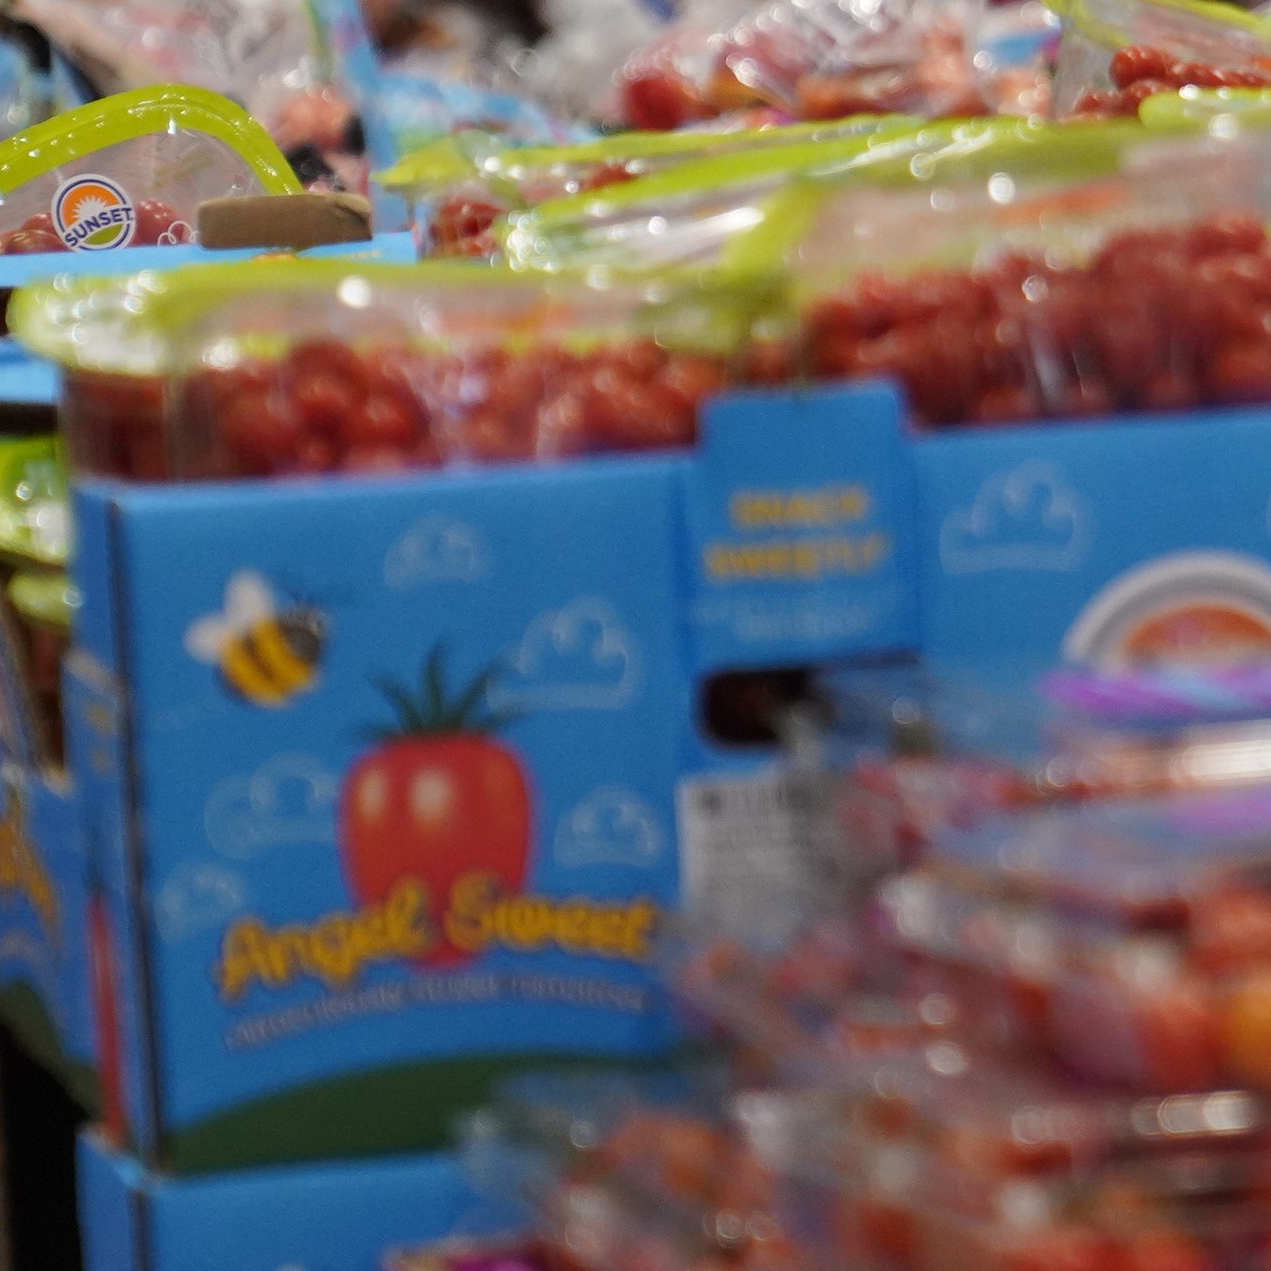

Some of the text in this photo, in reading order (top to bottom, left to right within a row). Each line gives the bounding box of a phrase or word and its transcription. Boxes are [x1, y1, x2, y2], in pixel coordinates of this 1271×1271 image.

[64, 207, 132, 248] SUNSET
[217, 867, 659, 1002] Angel Sweet
